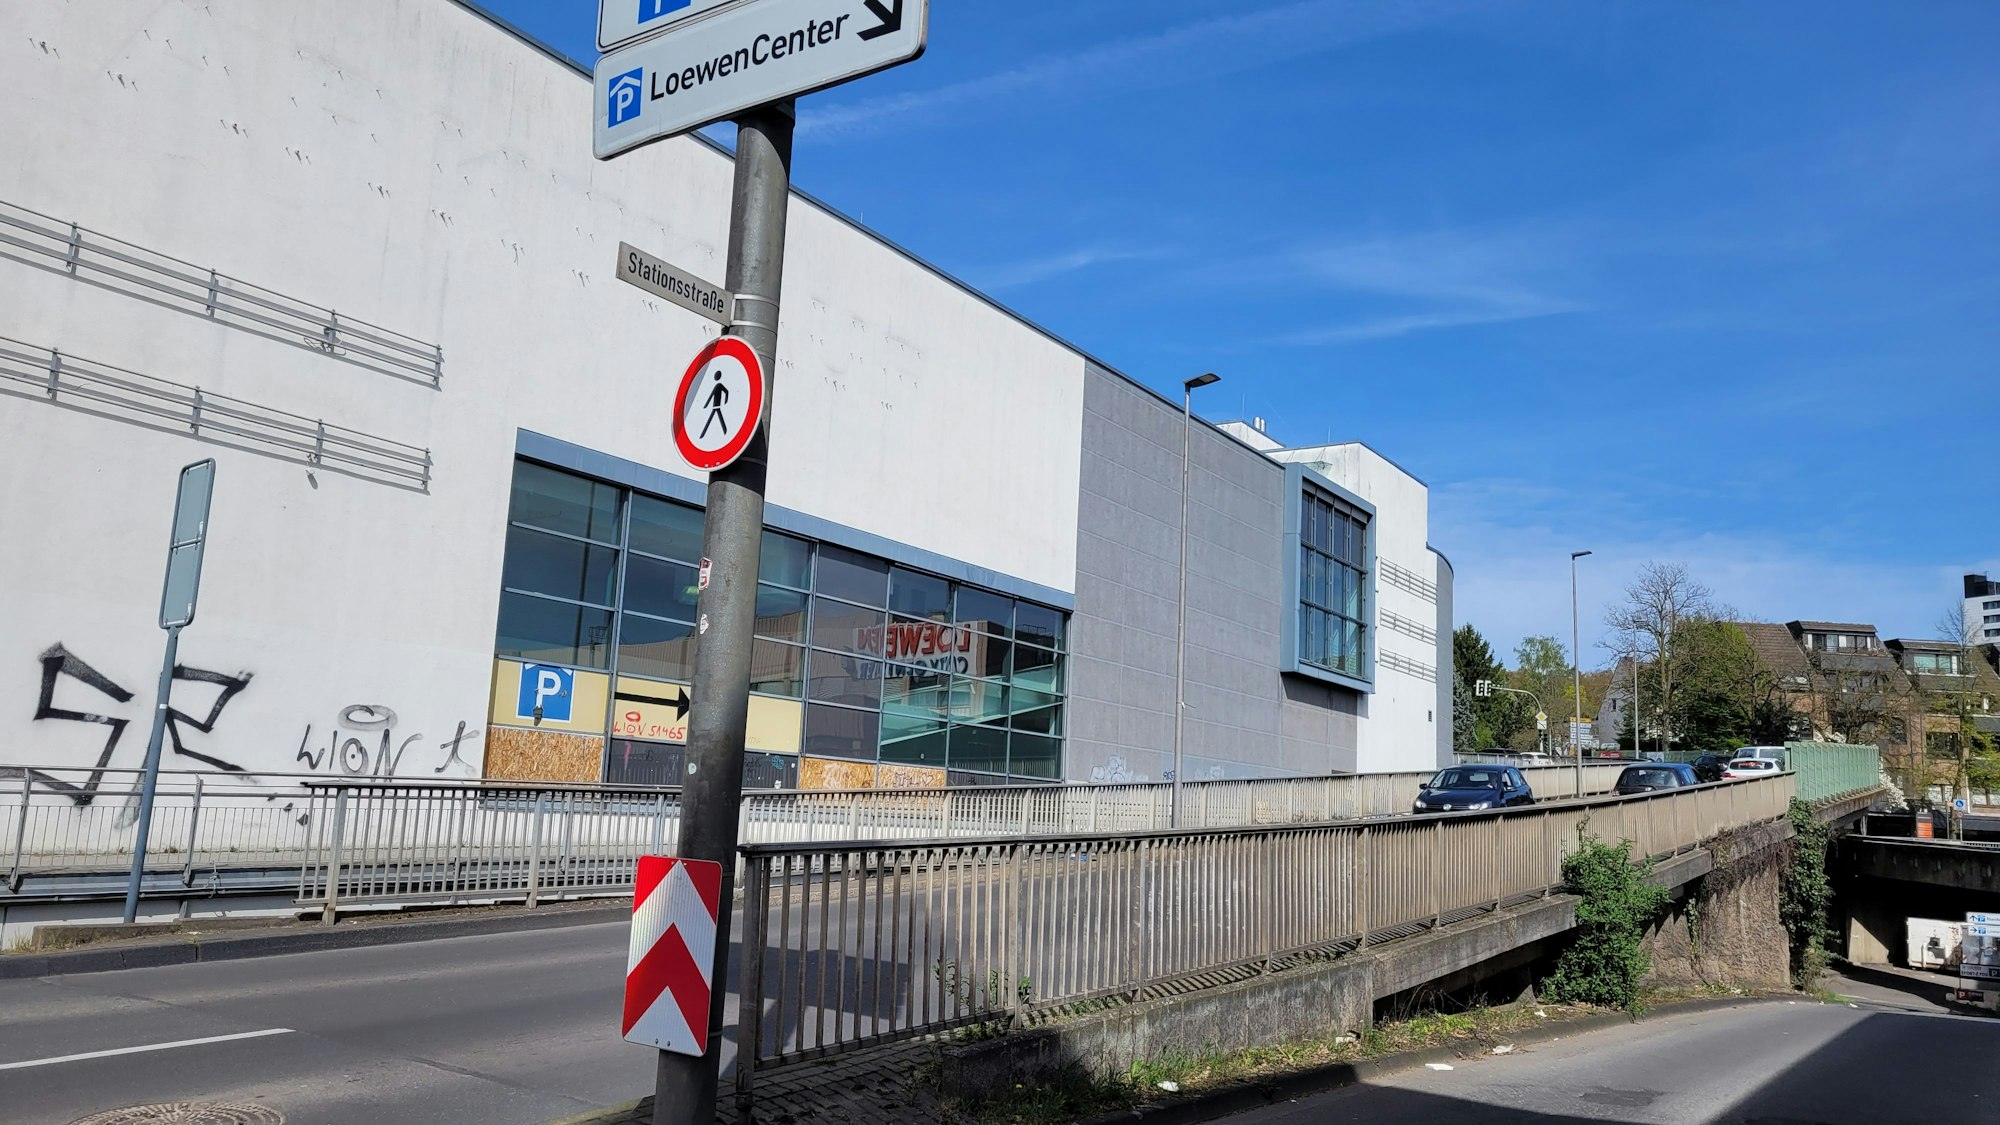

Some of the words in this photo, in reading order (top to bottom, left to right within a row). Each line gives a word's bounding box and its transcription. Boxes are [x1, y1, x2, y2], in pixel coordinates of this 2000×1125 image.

[617, 87, 634, 122] P
[651, 14, 850, 101] LoewenCenter
[628, 252, 724, 314] Stationsstraße
[536, 670, 562, 708] P
[648, 725, 687, 740] 51465
